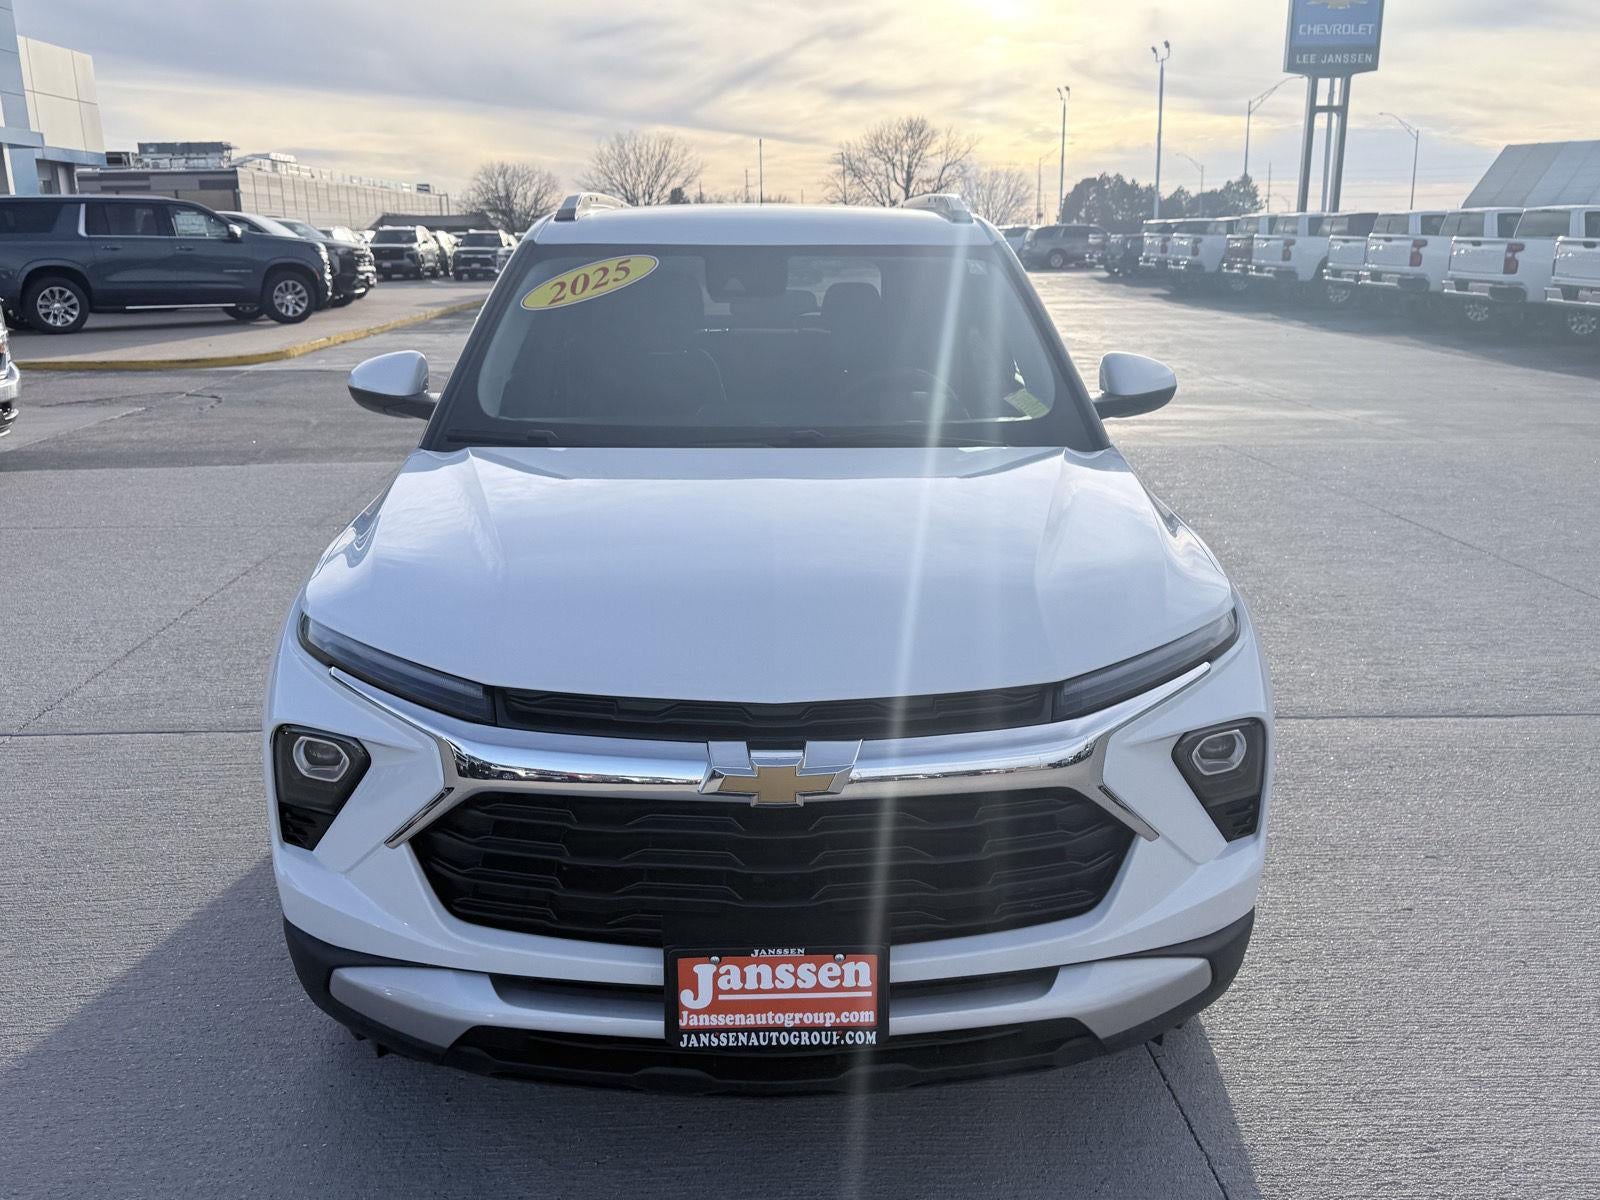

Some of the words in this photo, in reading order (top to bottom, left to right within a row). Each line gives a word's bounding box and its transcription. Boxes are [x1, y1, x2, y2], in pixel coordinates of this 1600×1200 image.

[1299, 23, 1375, 36] CHEVROLET
[1296, 54, 1316, 64] LEE
[1320, 53, 1373, 64] JANSSEN
[548, 258, 632, 305] 2025
[751, 948, 805, 957] JANSSEN
[680, 961, 872, 1009] Janssen
[679, 1010, 875, 1027] Janssenautogroup.com
